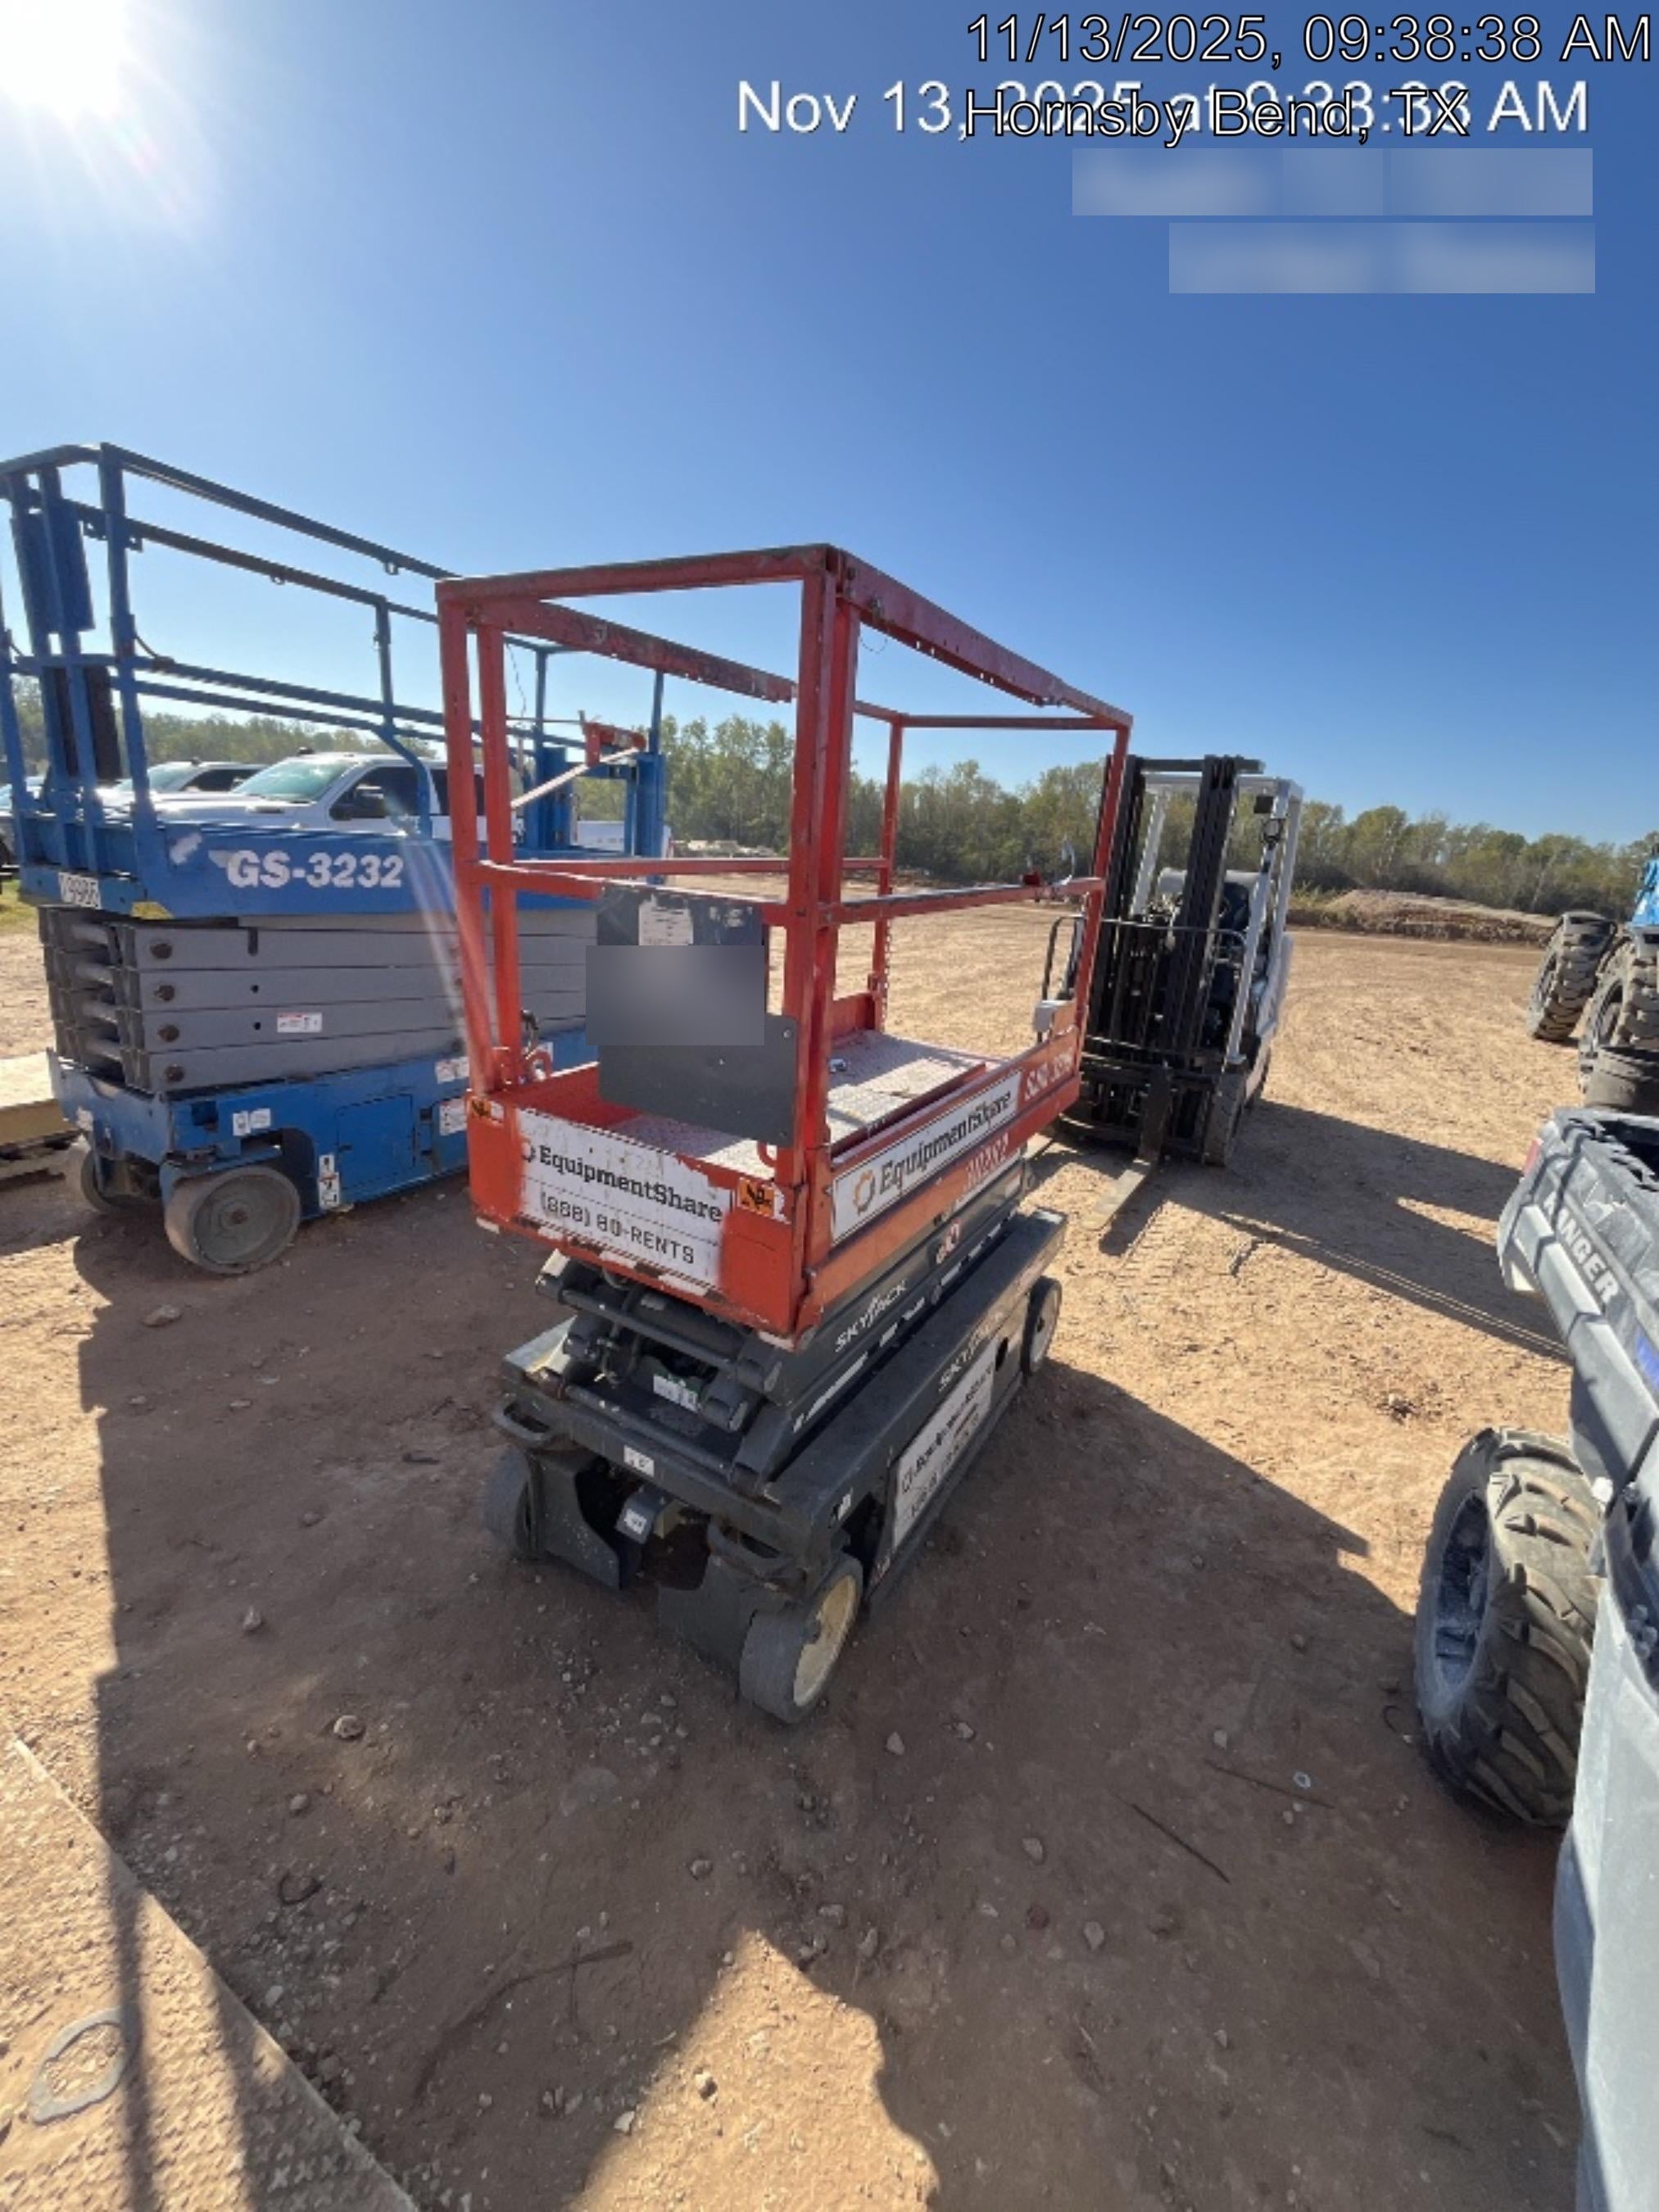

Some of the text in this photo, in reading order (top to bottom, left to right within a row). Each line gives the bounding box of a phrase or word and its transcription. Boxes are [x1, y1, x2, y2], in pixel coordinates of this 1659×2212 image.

[228, 850, 404, 888] GS-3232
[539, 1145, 723, 1222] EquipmentShare
[596, 1213, 695, 1264] 80-RENTS
